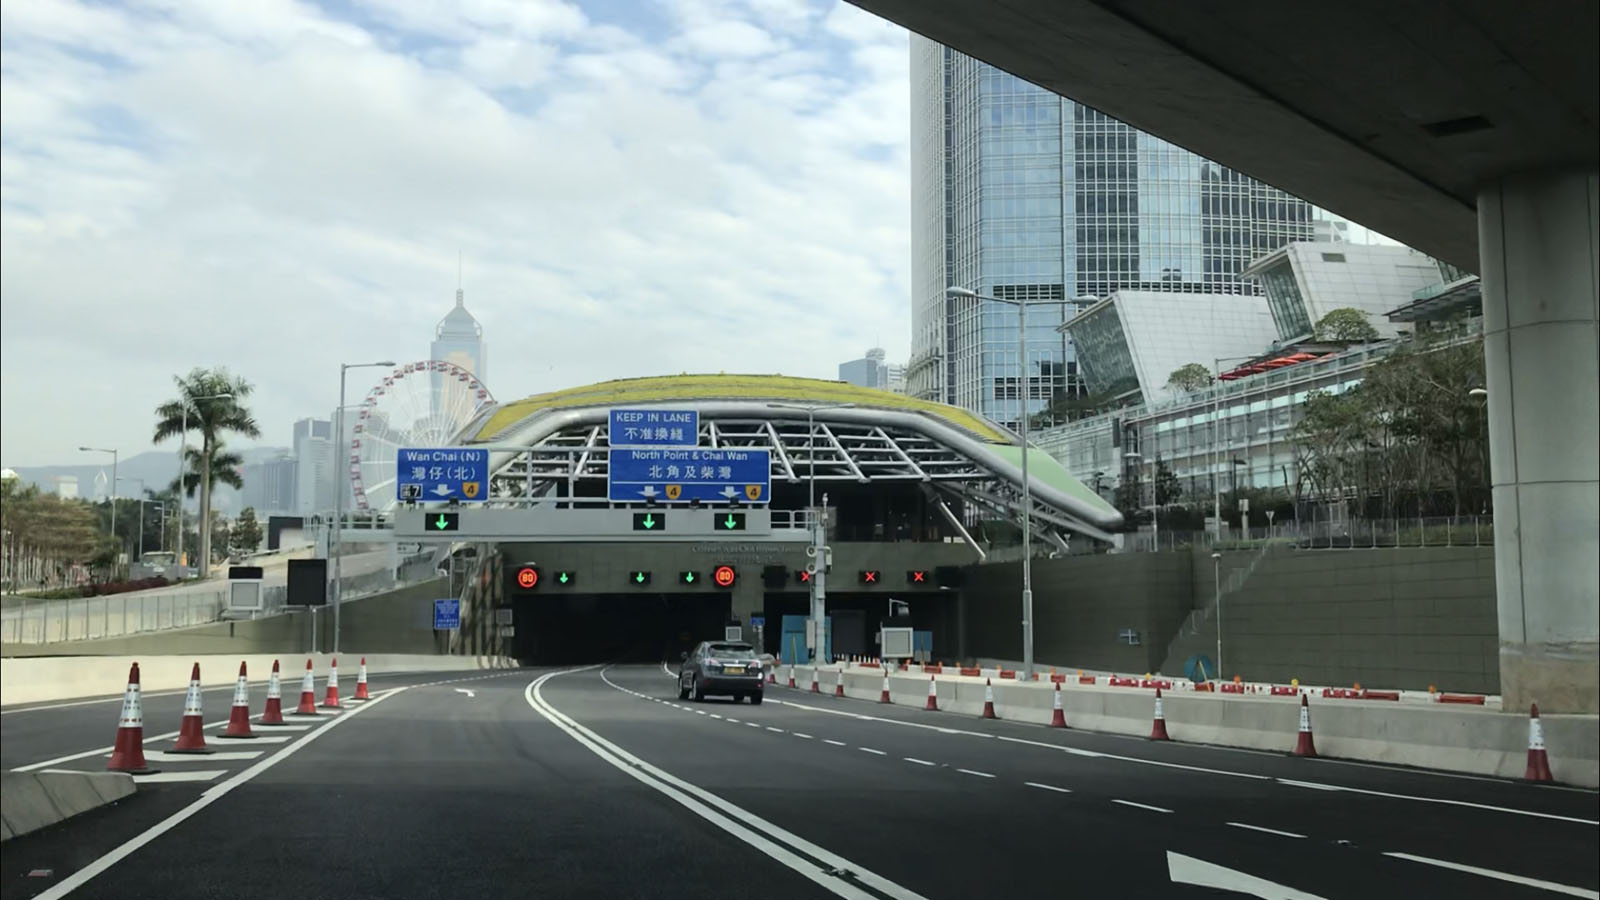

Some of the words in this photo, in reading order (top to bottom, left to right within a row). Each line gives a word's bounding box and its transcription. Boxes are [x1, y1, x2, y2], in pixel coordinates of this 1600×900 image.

[616, 412, 643, 422] KEEP
[647, 412, 659, 422] IN
[663, 412, 691, 422] LANE
[407, 451, 430, 461] Wan
[432, 451, 457, 461] Chai
[460, 451, 480, 462] (N)
[632, 451, 660, 460] North
[663, 451, 689, 460] Point
[692, 451, 699, 460] &
[702, 451, 724, 460] Chai
[727, 451, 748, 460] Wan
[649, 465, 732, 479] 北角及柴灣
[413, 485, 420, 497] 7
[466, 485, 474, 494] 4
[670, 487, 677, 496] 4
[750, 487, 757, 496] 4
[522, 572, 534, 583] 80
[719, 571, 731, 581] 80
